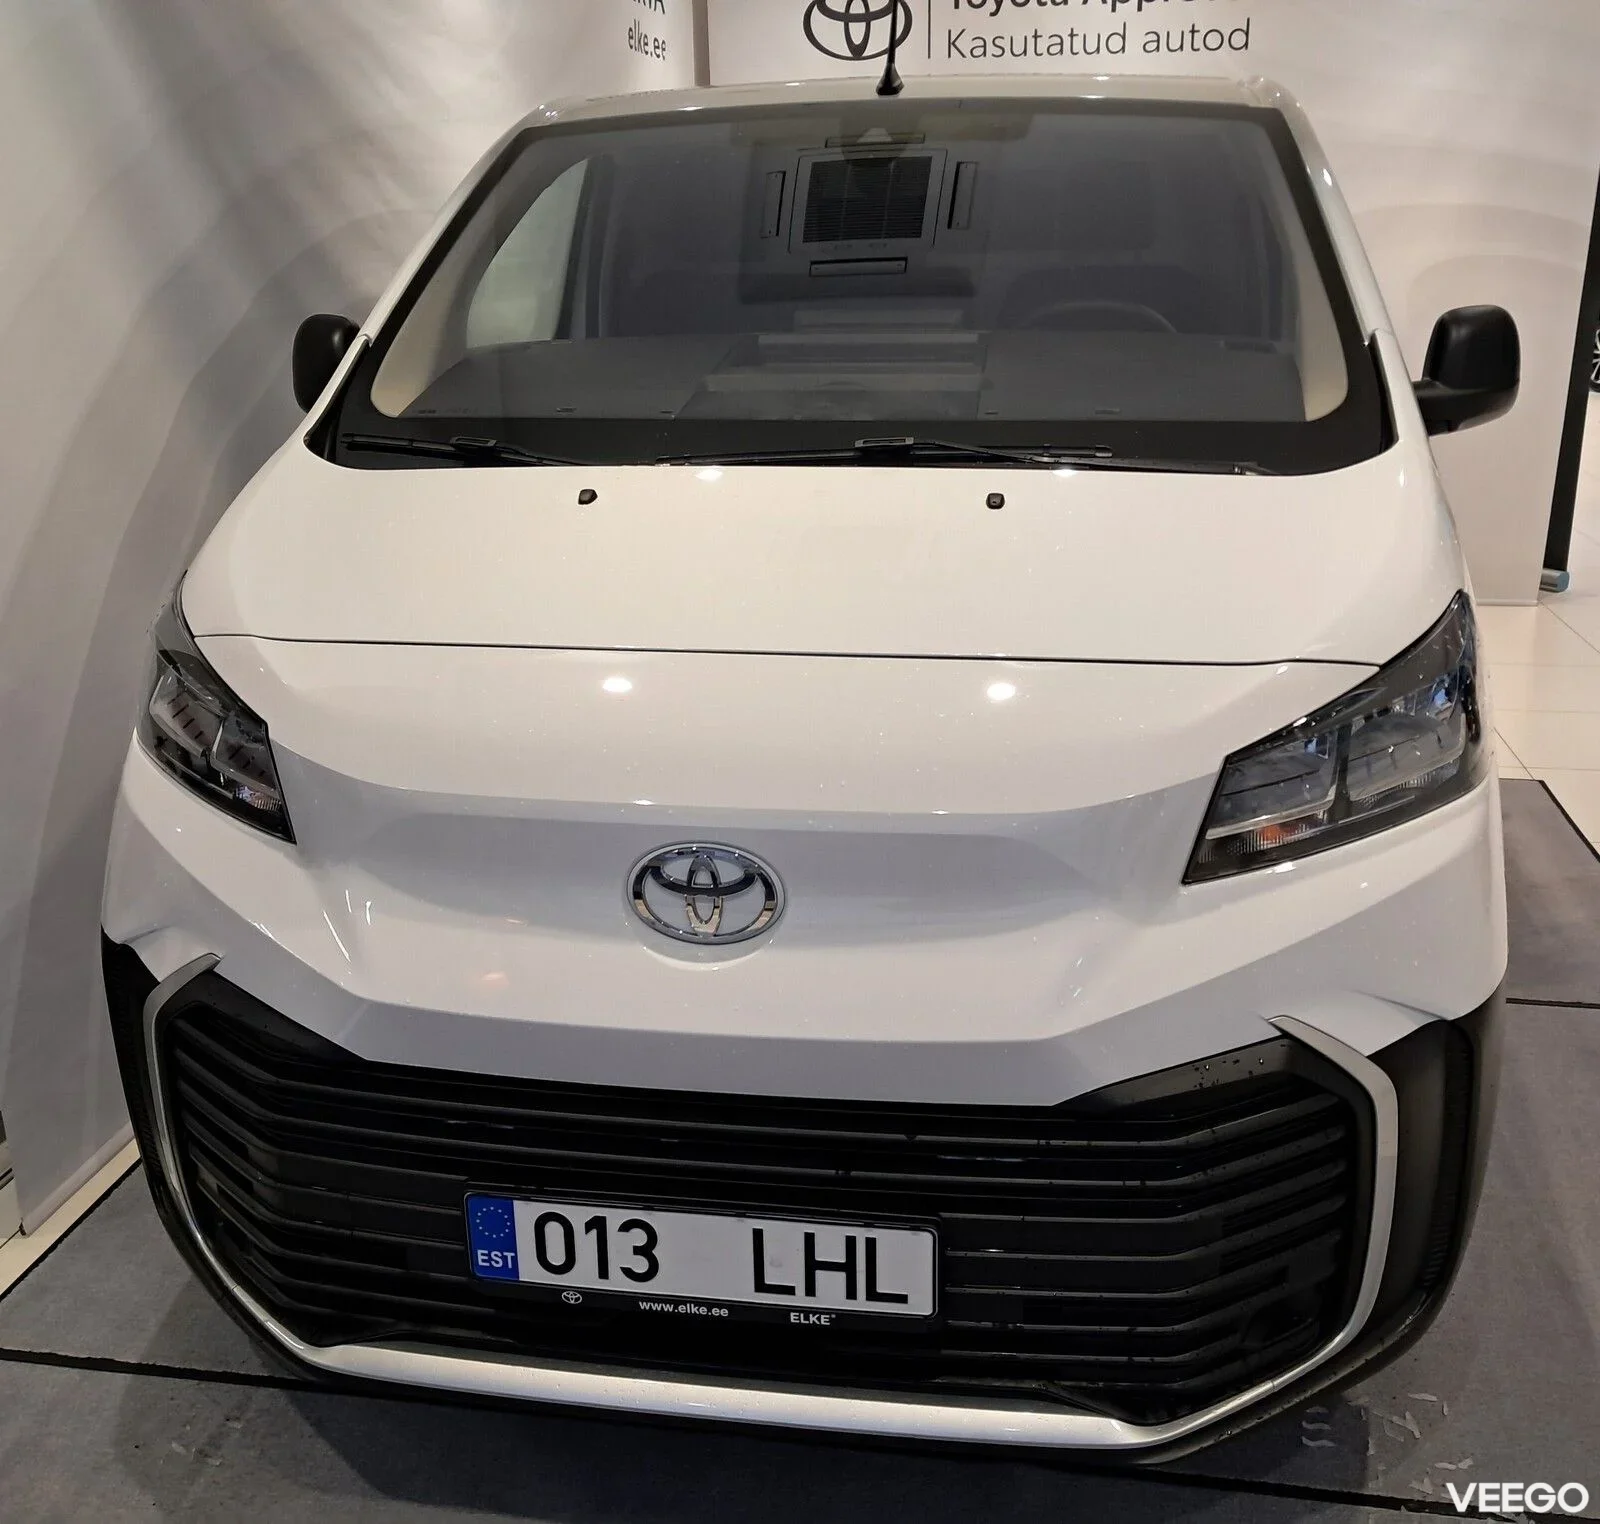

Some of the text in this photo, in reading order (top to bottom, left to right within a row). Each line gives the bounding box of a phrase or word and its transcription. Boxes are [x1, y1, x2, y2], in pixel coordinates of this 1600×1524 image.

[627, 18, 667, 61] elke.ee
[947, 17, 1251, 59] Kasutatud autod
[477, 1249, 516, 1269] EST
[533, 1211, 909, 1305] 013 LHL
[638, 1300, 729, 1317] www.elke.ee
